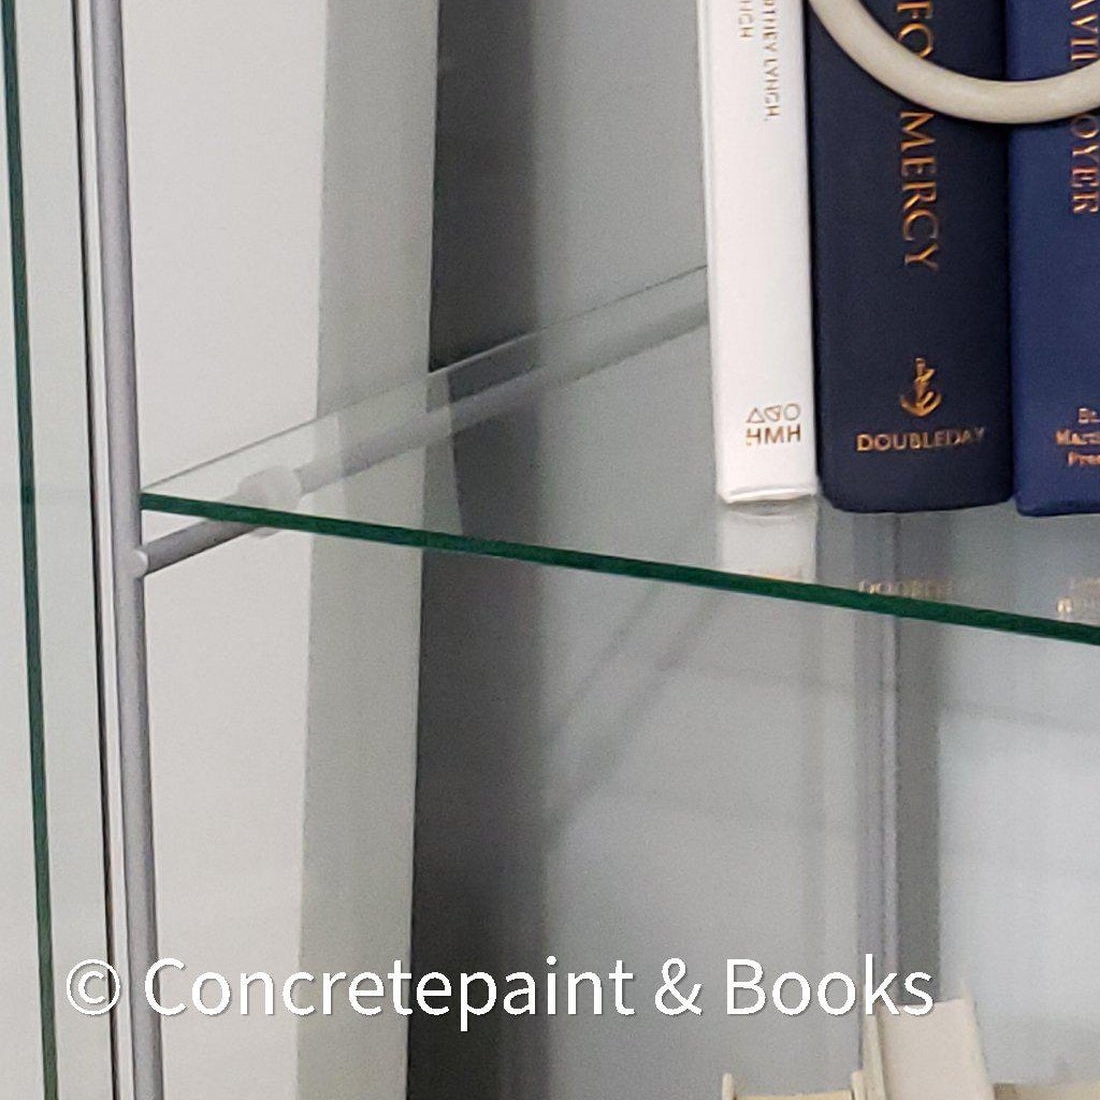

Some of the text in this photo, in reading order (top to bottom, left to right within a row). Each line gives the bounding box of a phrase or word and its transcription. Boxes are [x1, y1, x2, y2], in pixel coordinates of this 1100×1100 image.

[894, 0, 934, 60] FO
[899, 108, 941, 272] MERCY
[1069, 114, 1100, 215] OYER
[745, 424, 801, 447] HMH
[856, 426, 985, 452] DOUBLEDAY
